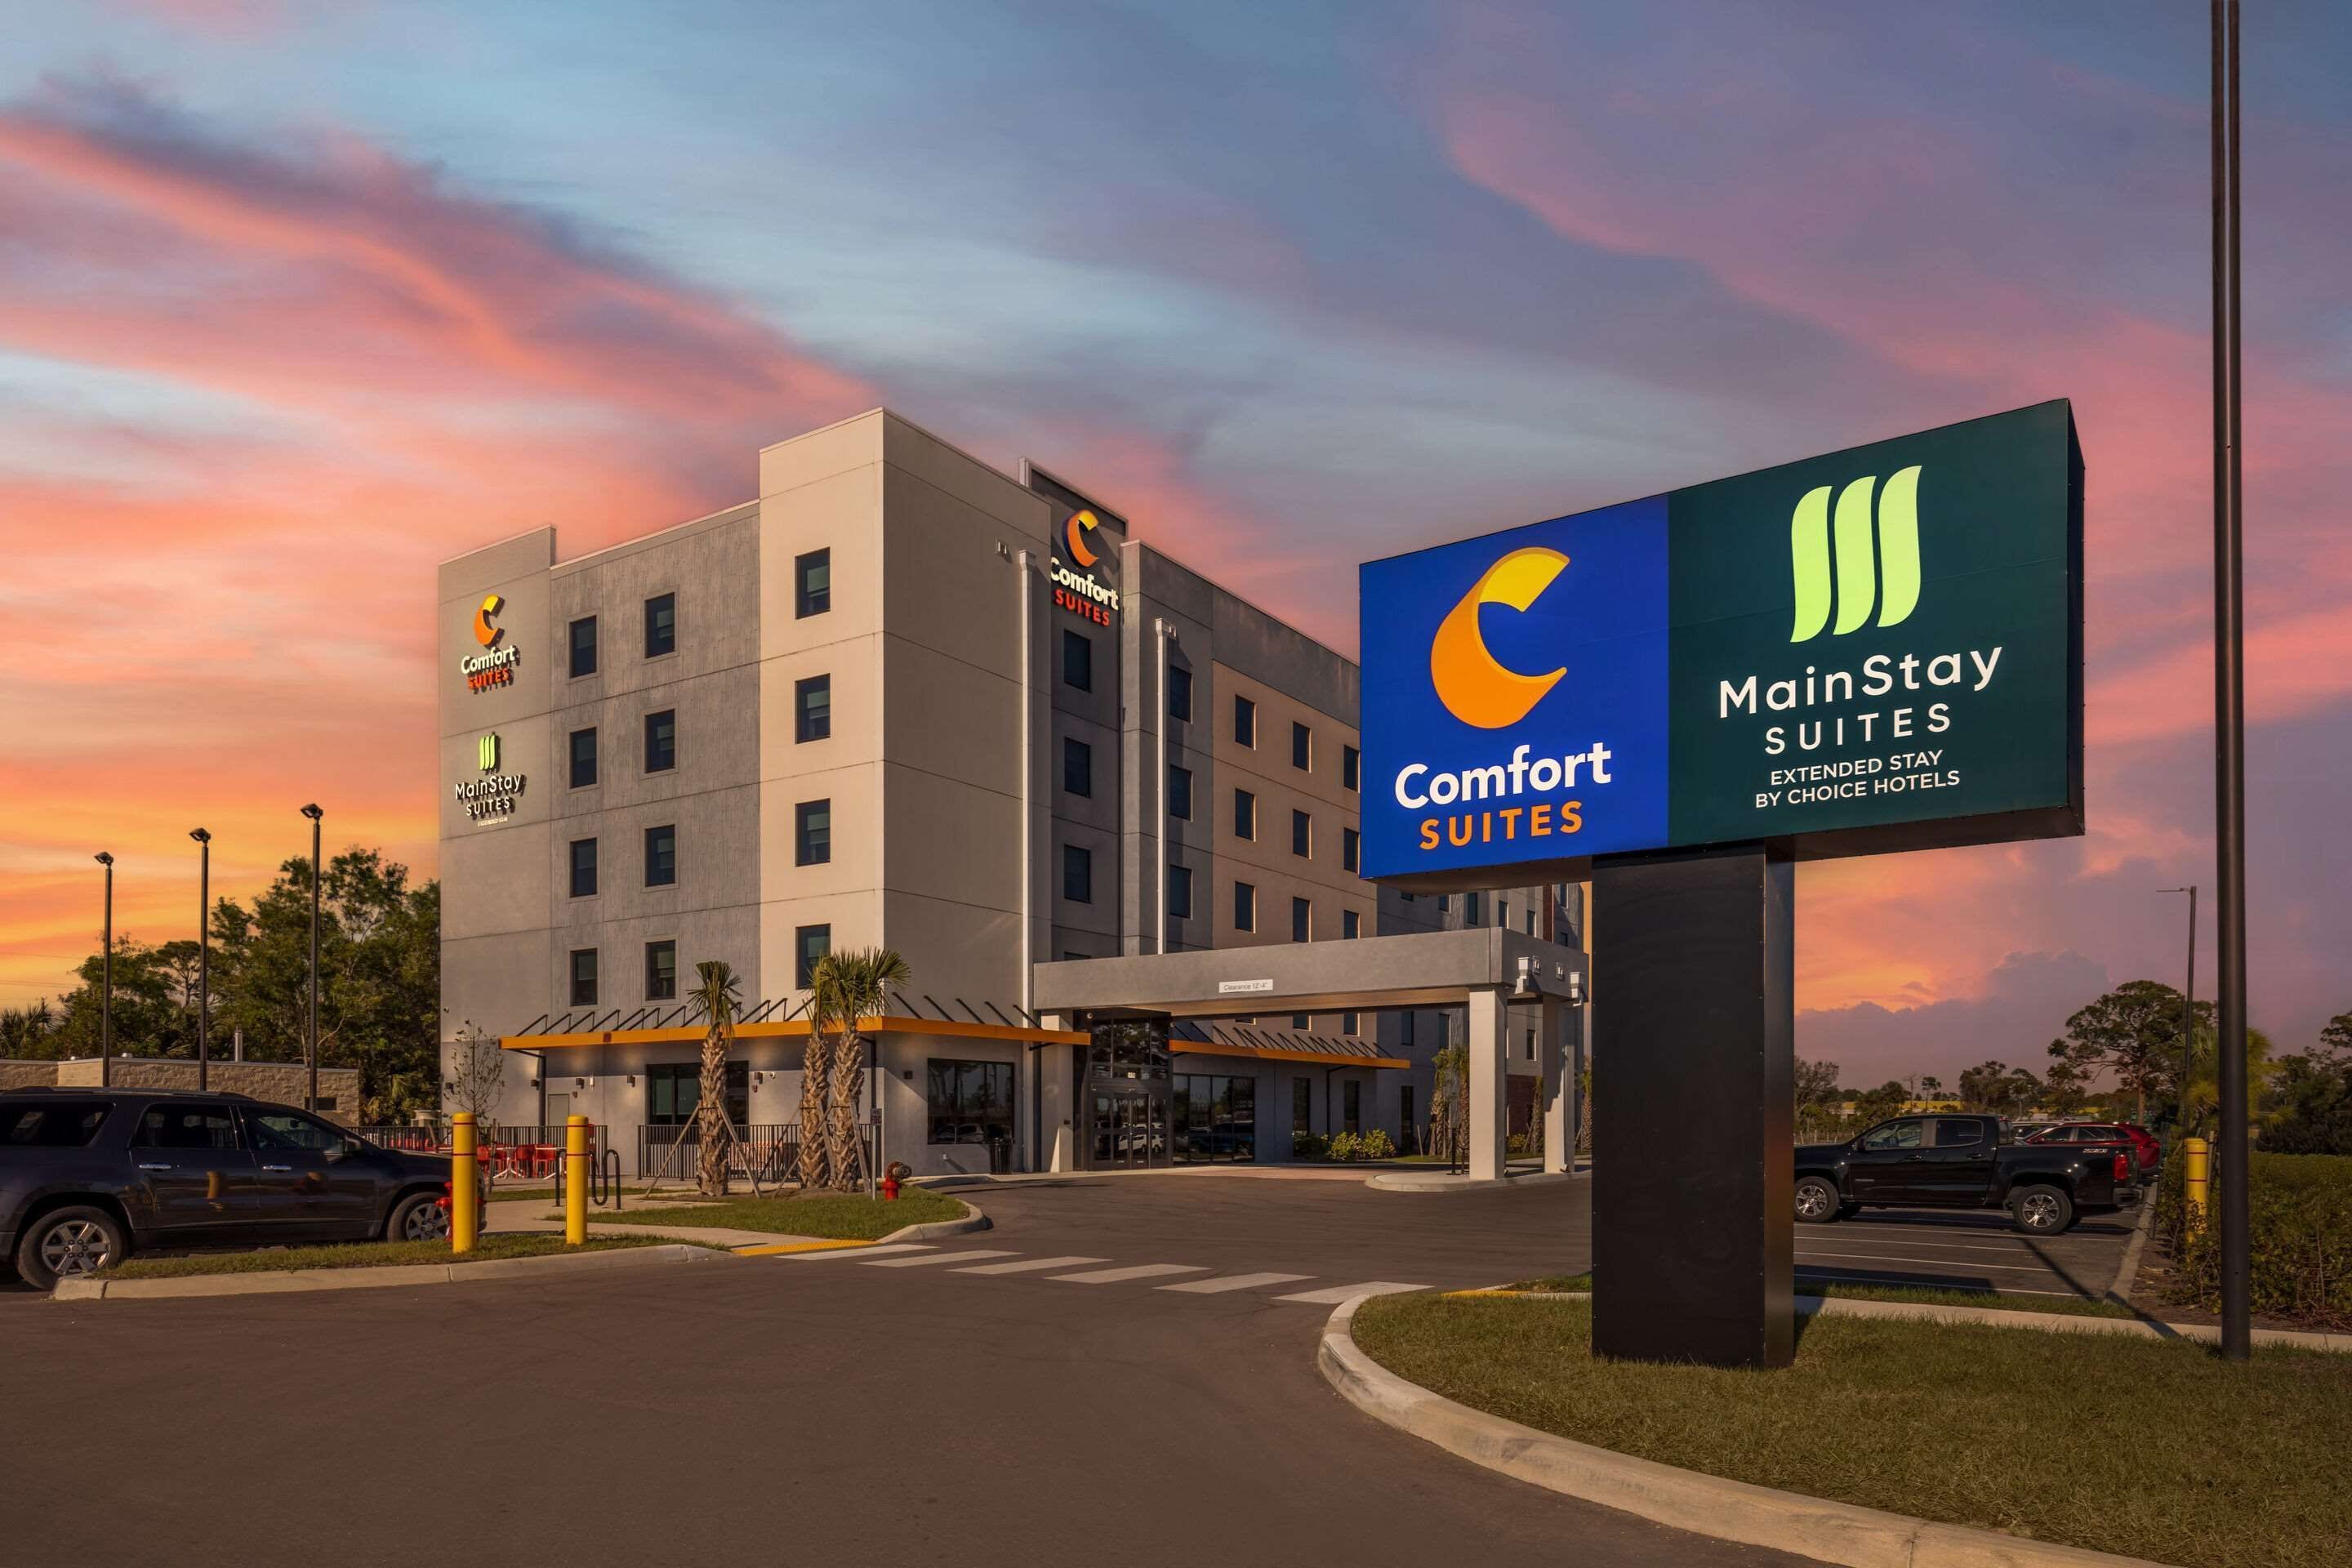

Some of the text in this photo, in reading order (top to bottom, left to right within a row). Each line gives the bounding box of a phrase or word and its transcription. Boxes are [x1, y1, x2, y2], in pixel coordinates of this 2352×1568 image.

[1050, 556, 1119, 610] Comfort
[1054, 588, 1111, 626] SUITES
[461, 644, 515, 674] Comfort
[467, 667, 510, 690] SUITES
[1719, 646, 2002, 719] MainStay
[1764, 702, 1951, 755] SUITES
[455, 773, 521, 800] MainStay
[1395, 742, 1611, 809] Comfort
[1771, 749, 1943, 786] EXTENDED STAY
[466, 796, 510, 816] SUITES
[1755, 769, 1961, 808] BY CHOICE HOTELS
[1419, 800, 1583, 850] SUITES
